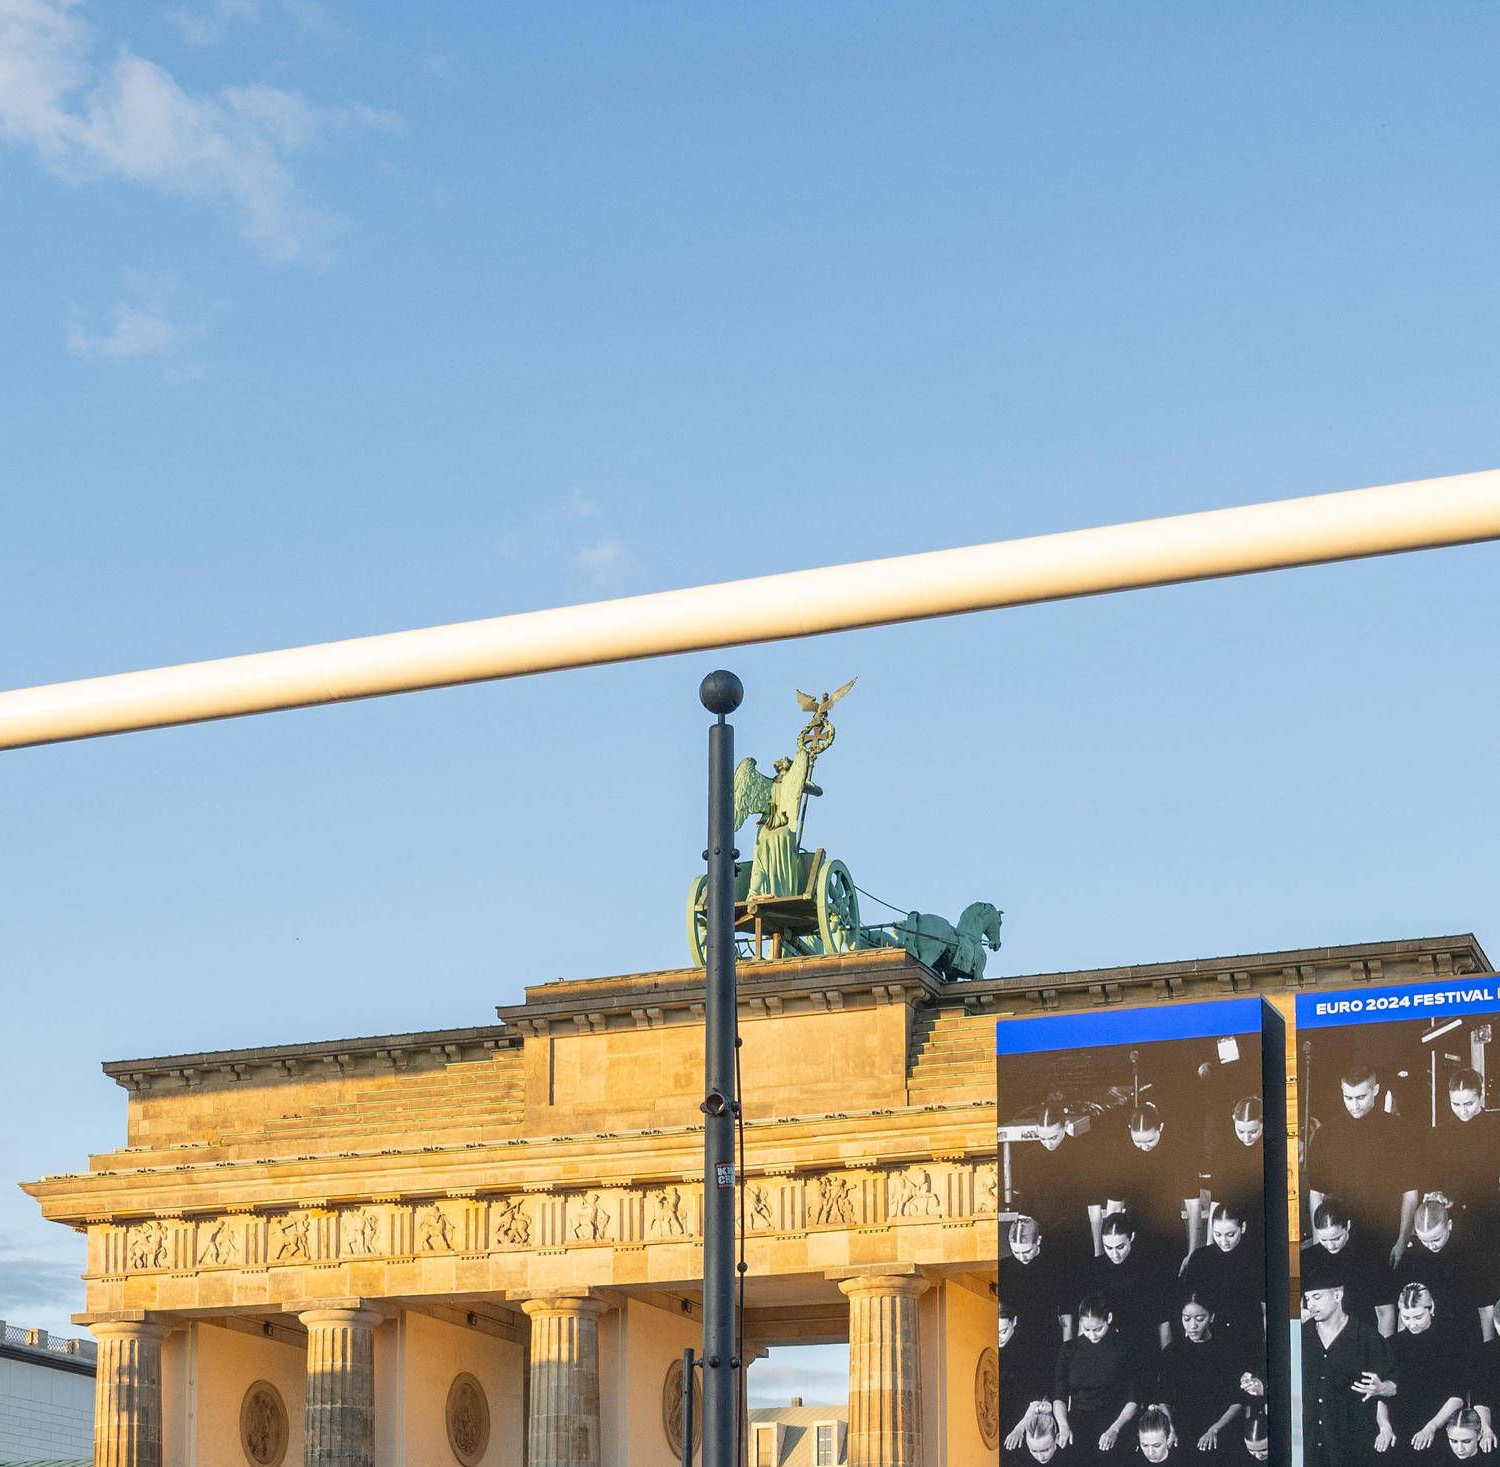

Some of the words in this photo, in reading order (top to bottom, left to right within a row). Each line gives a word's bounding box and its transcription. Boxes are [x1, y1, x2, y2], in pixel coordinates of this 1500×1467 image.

[1316, 999, 1363, 1016] EURO
[1365, 995, 1410, 1011] 2024
[1413, 987, 1493, 1006] FESTIVAL
